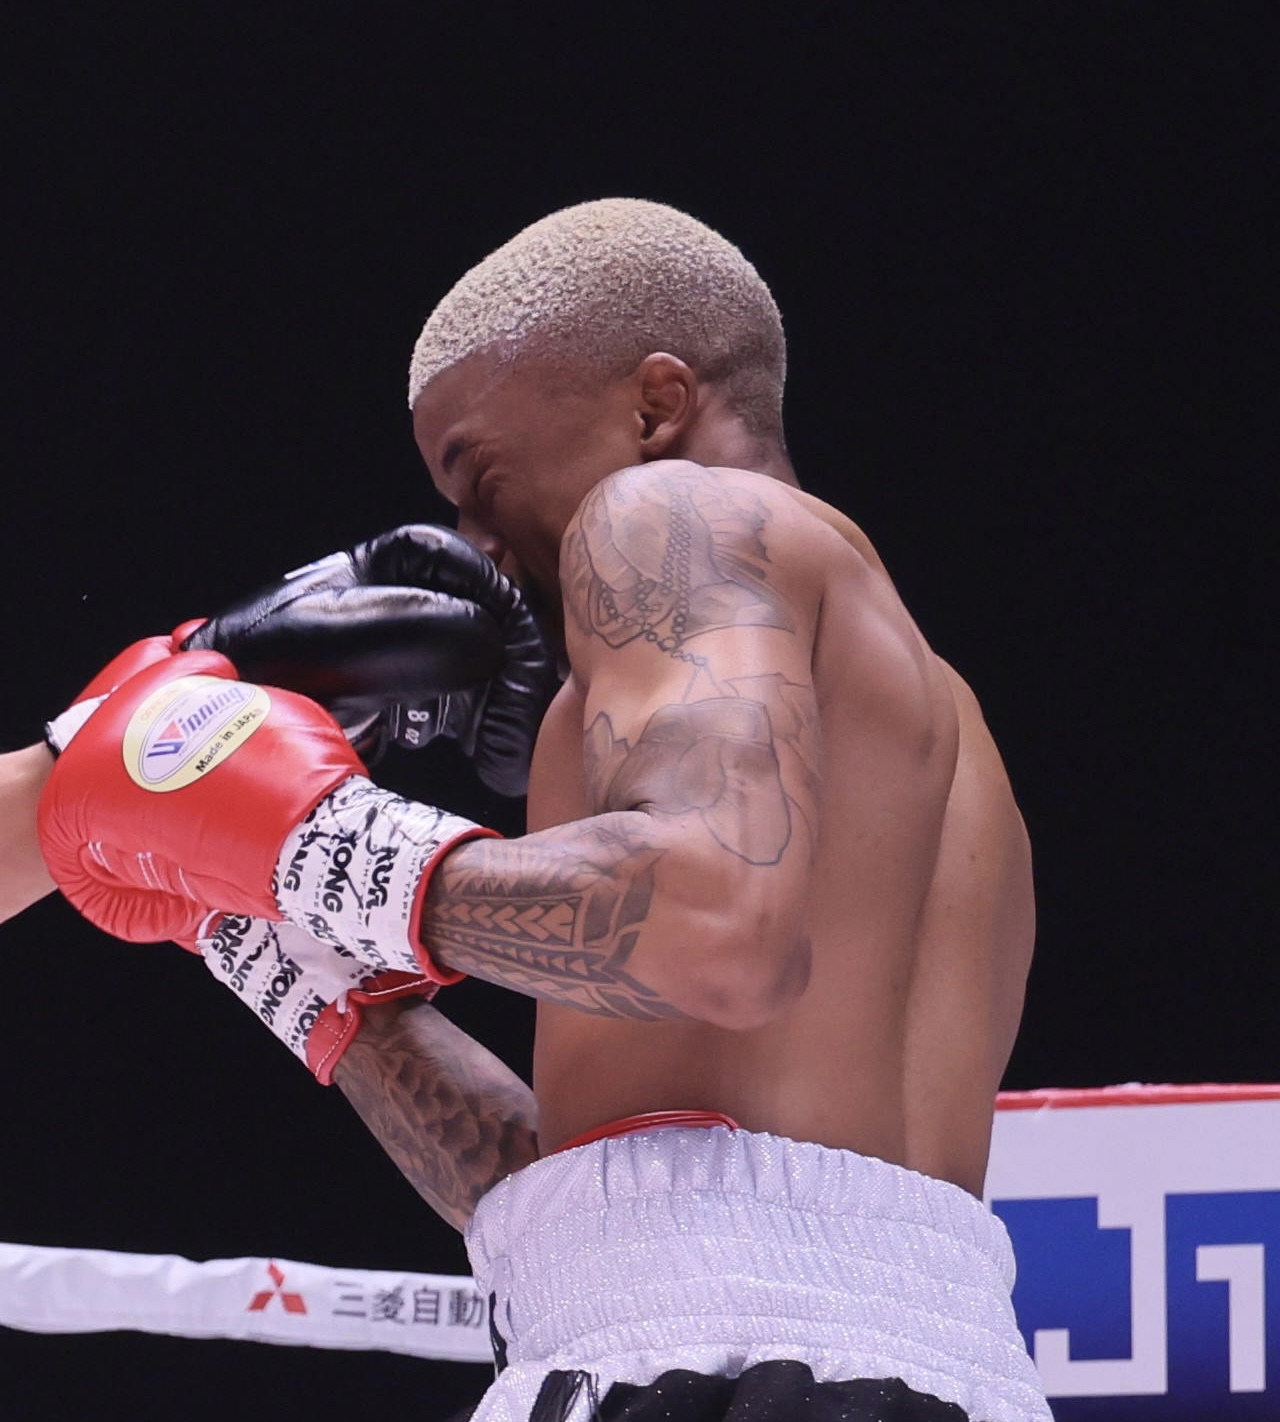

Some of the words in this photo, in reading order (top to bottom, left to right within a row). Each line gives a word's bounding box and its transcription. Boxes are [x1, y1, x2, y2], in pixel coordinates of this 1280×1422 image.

[195, 741, 224, 772] Made
[332, 1280, 486, 1329] 三菱自動
